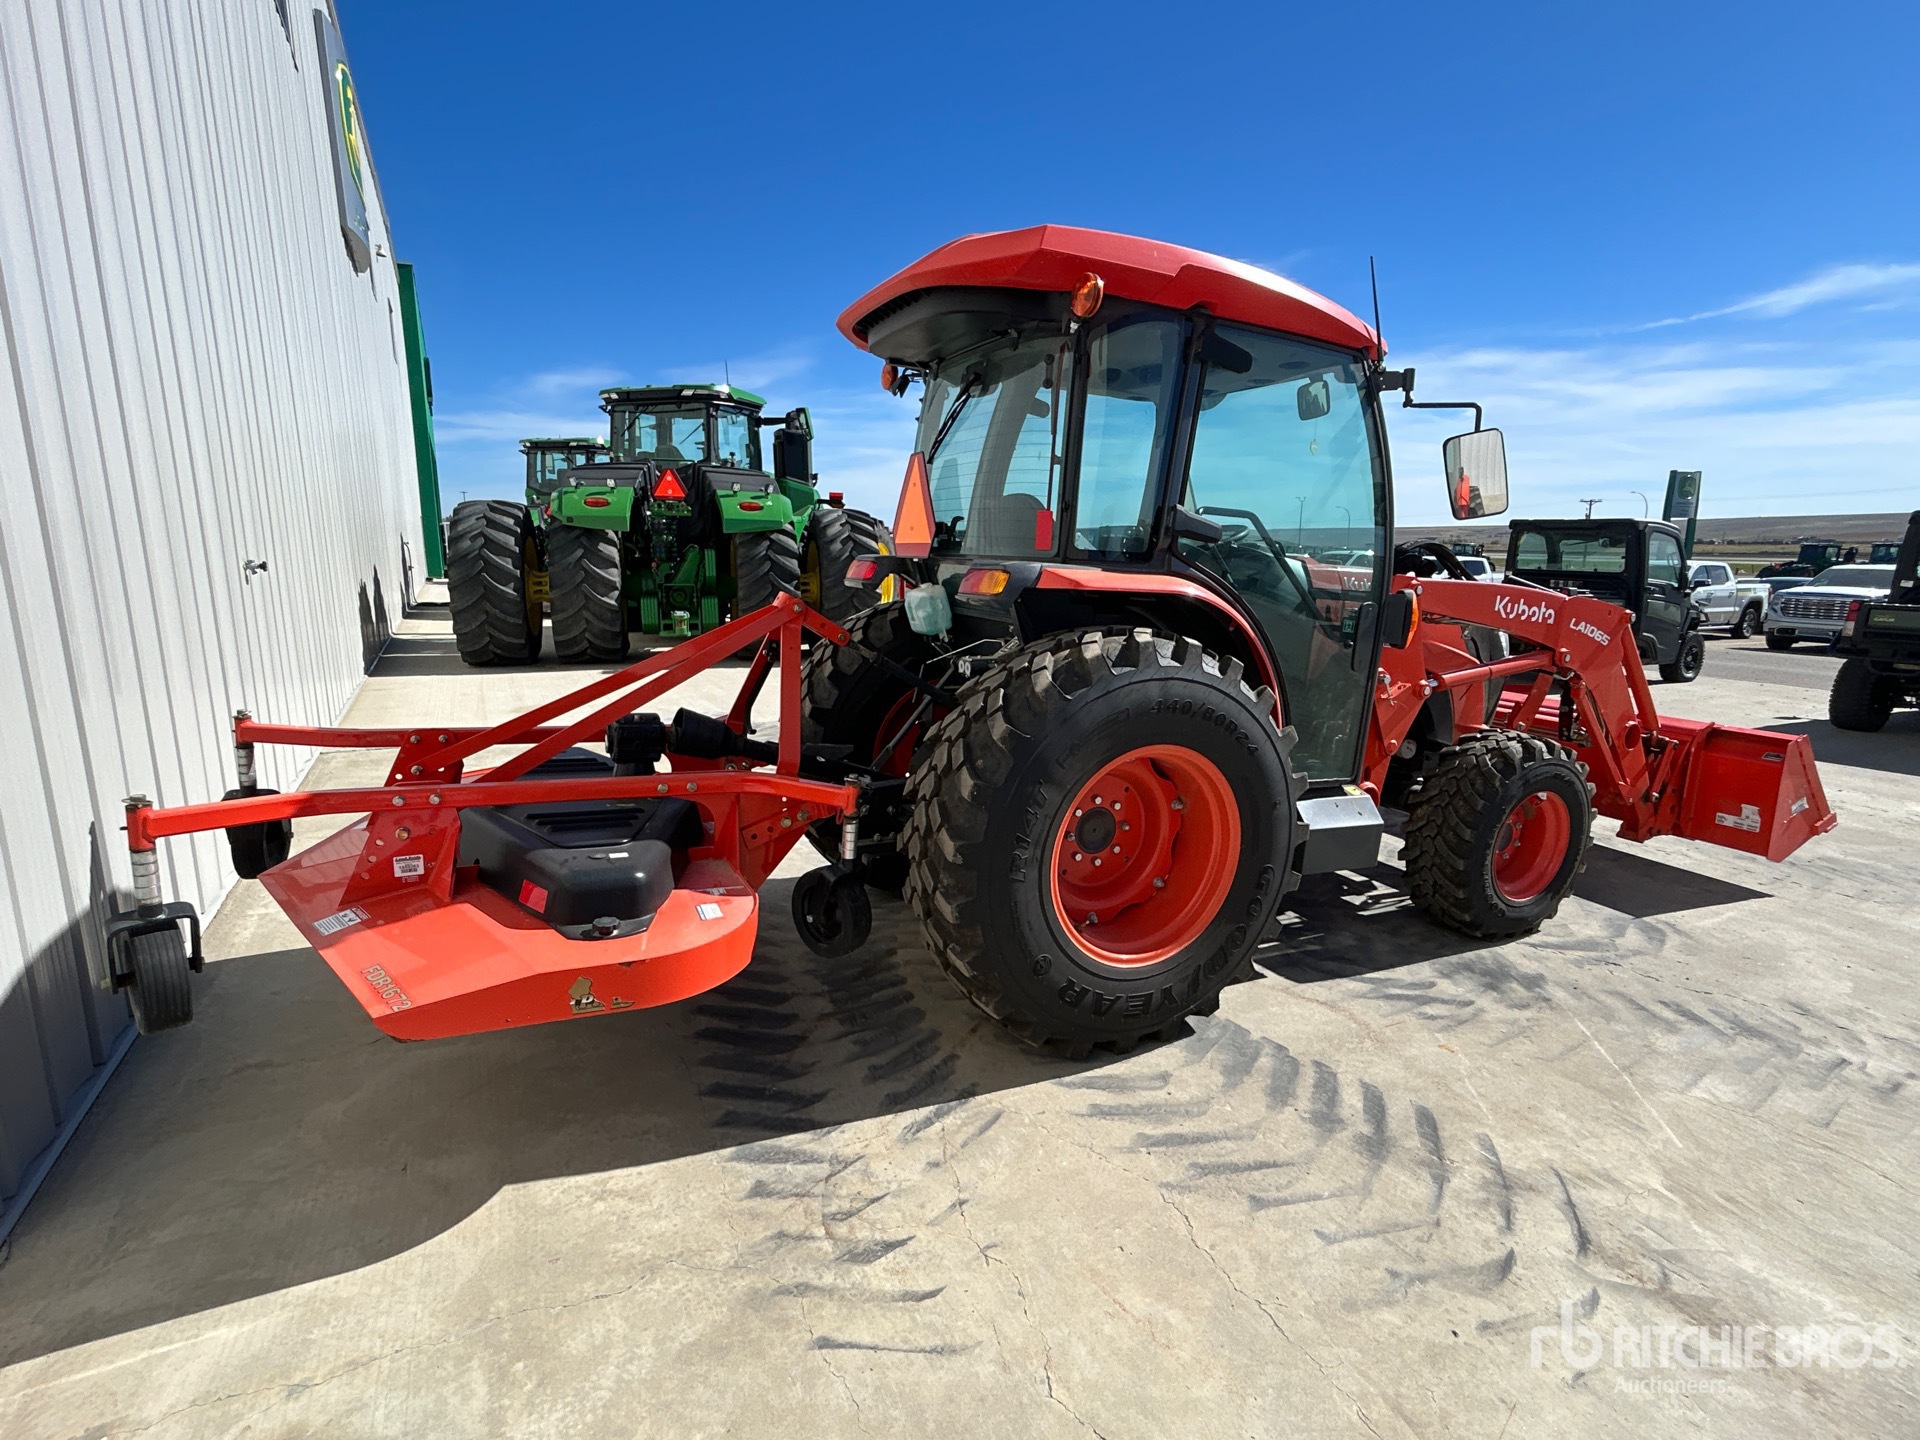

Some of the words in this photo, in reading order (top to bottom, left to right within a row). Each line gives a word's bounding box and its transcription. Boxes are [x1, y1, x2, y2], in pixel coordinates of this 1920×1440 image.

[1494, 595, 1555, 625] Kubota
[1569, 617, 1611, 646] LA1065
[361, 964, 412, 1012] FDR1672
